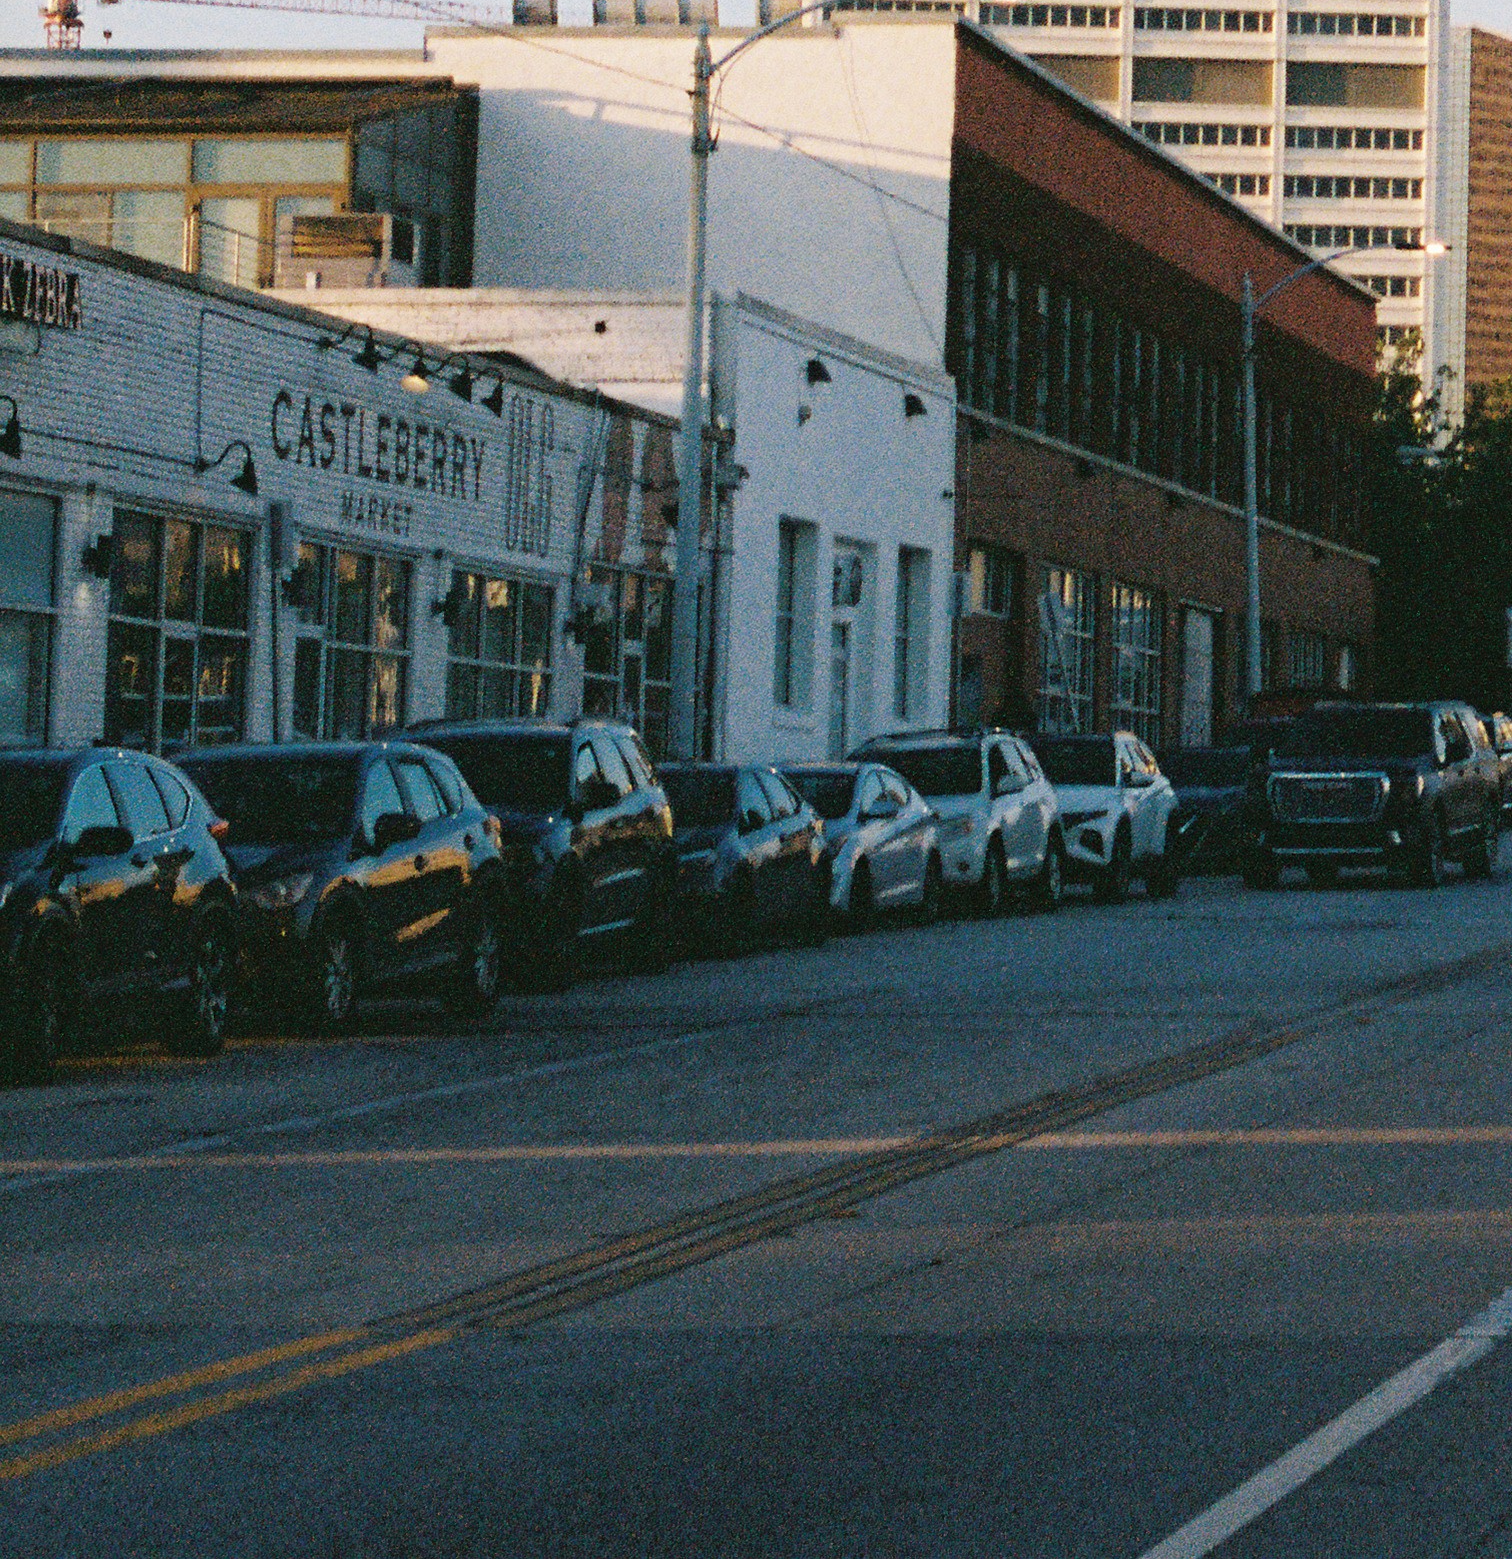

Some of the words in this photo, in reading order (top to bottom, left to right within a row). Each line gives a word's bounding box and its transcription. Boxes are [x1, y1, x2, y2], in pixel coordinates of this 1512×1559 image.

[23, 260, 82, 330] ZEBRA
[271, 389, 486, 501] CASTLEBERRY
[340, 490, 413, 537] MARKET
